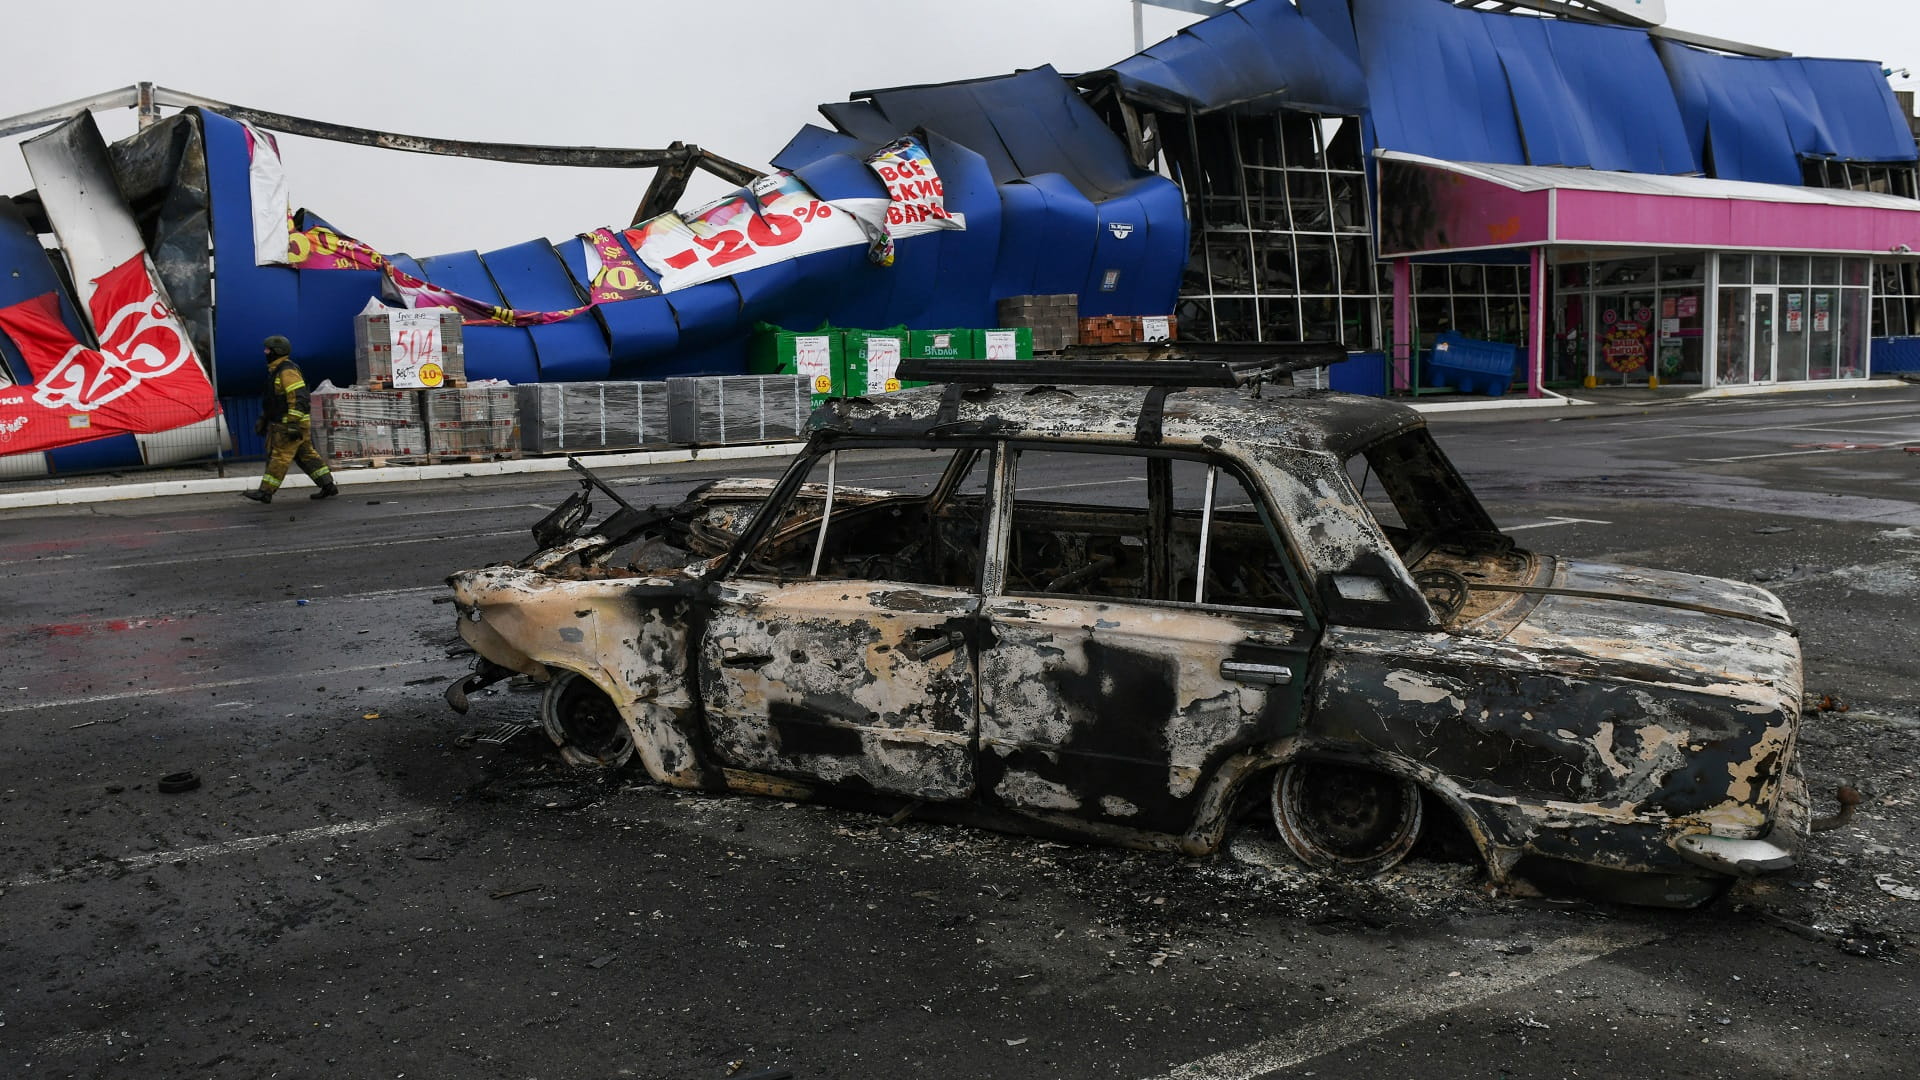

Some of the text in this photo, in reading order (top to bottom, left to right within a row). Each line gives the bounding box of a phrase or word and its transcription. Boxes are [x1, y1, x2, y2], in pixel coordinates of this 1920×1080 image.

[878, 159, 926, 182] ВСЕ
[884, 202, 953, 225] ВАРЫ
[663, 200, 832, 269] -20%
[394, 328, 434, 364] 504
